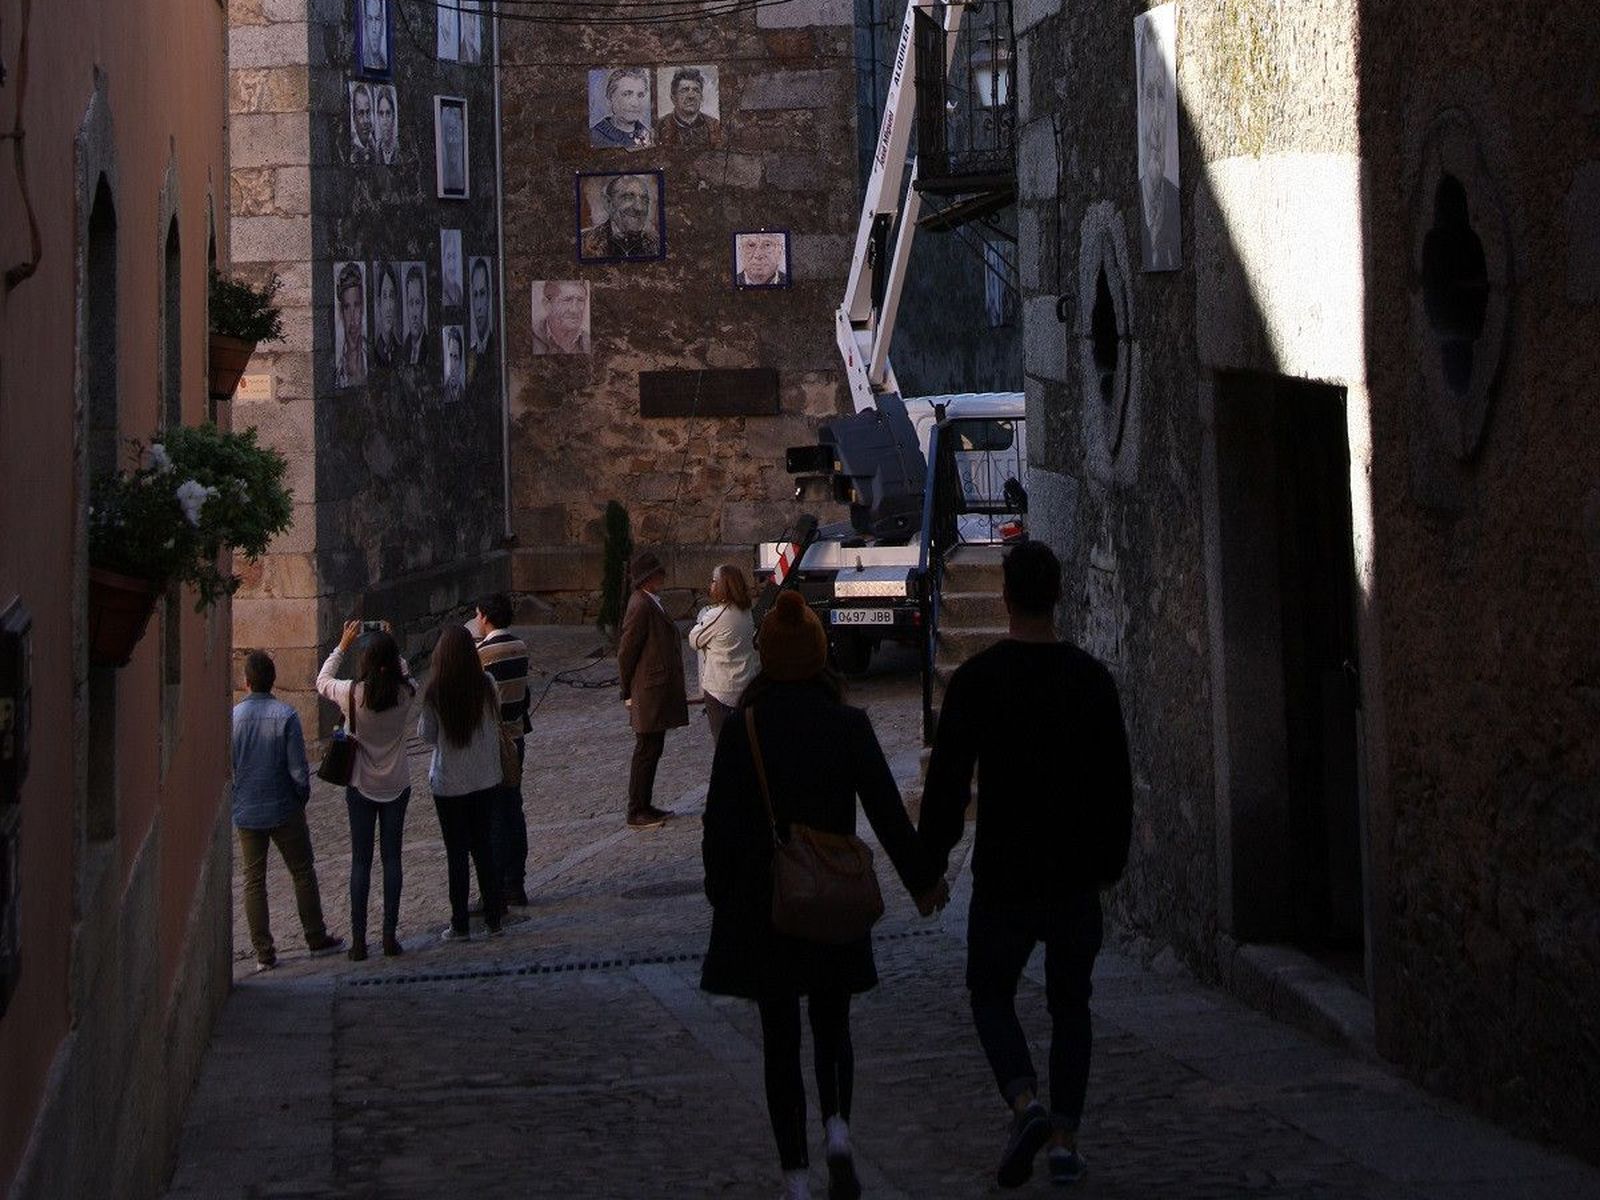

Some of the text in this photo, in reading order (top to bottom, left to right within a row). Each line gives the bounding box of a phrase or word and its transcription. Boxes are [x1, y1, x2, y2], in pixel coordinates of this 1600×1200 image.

[894, 23, 910, 87] ALQUILER
[838, 611, 866, 623] 0497
[869, 611, 891, 623] JBB
